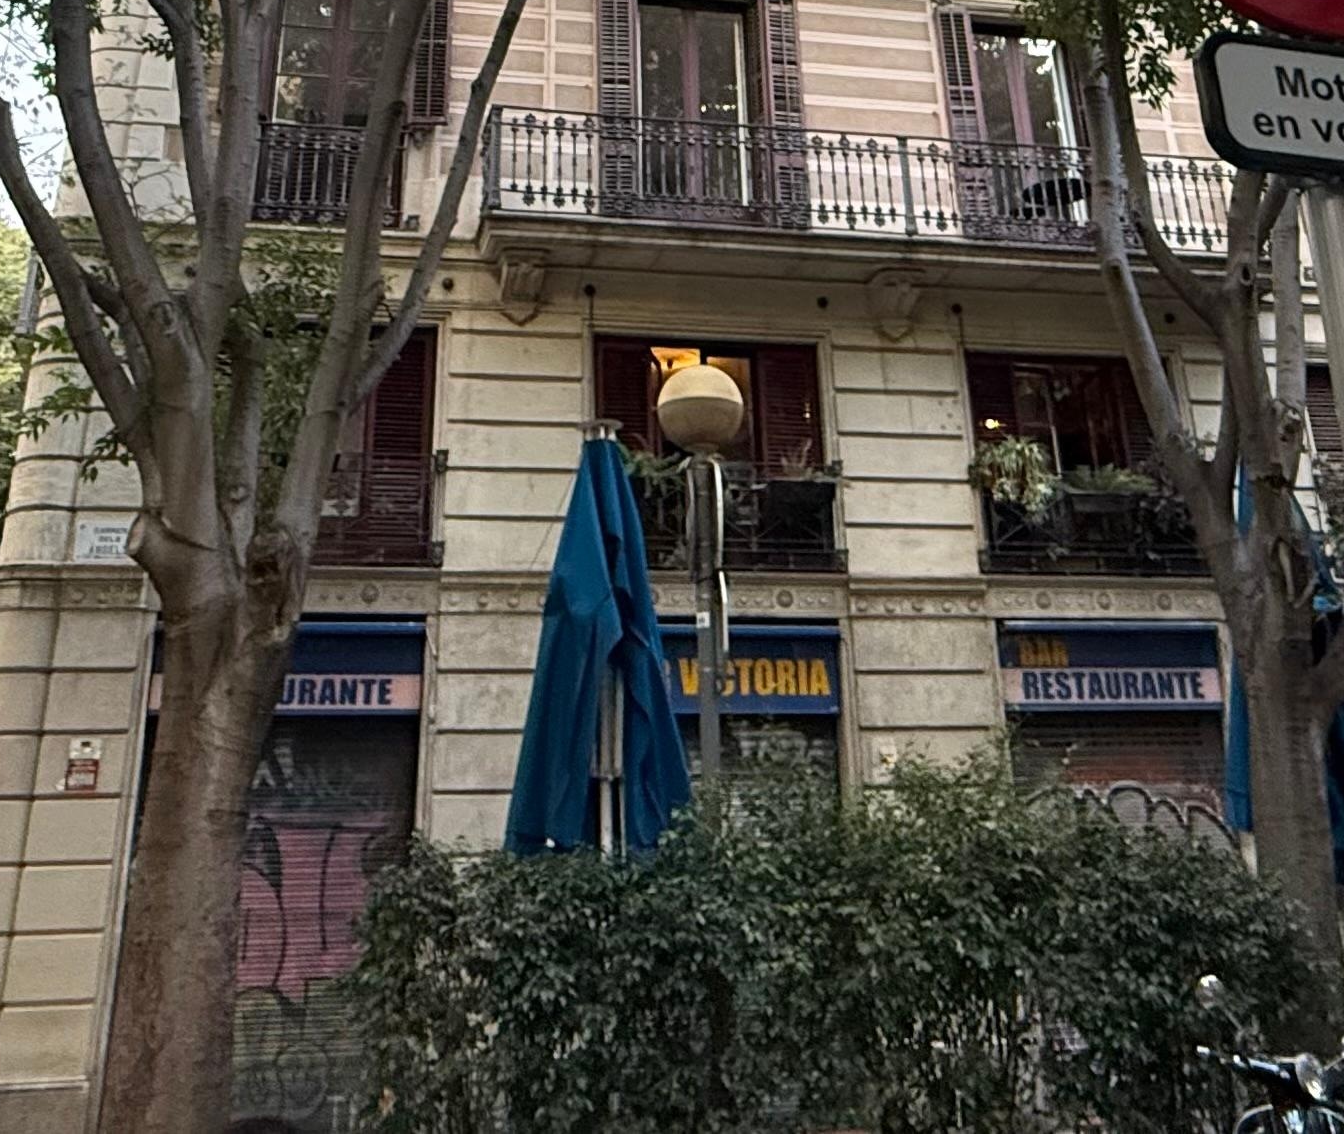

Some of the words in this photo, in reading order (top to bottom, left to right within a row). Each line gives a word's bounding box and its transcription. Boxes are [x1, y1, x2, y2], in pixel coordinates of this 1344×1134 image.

[1253, 112, 1301, 139] en
[1019, 635, 1069, 666] BAR
[679, 658, 831, 696] VCTORIA
[1022, 672, 1205, 700] RESTAURANTE
